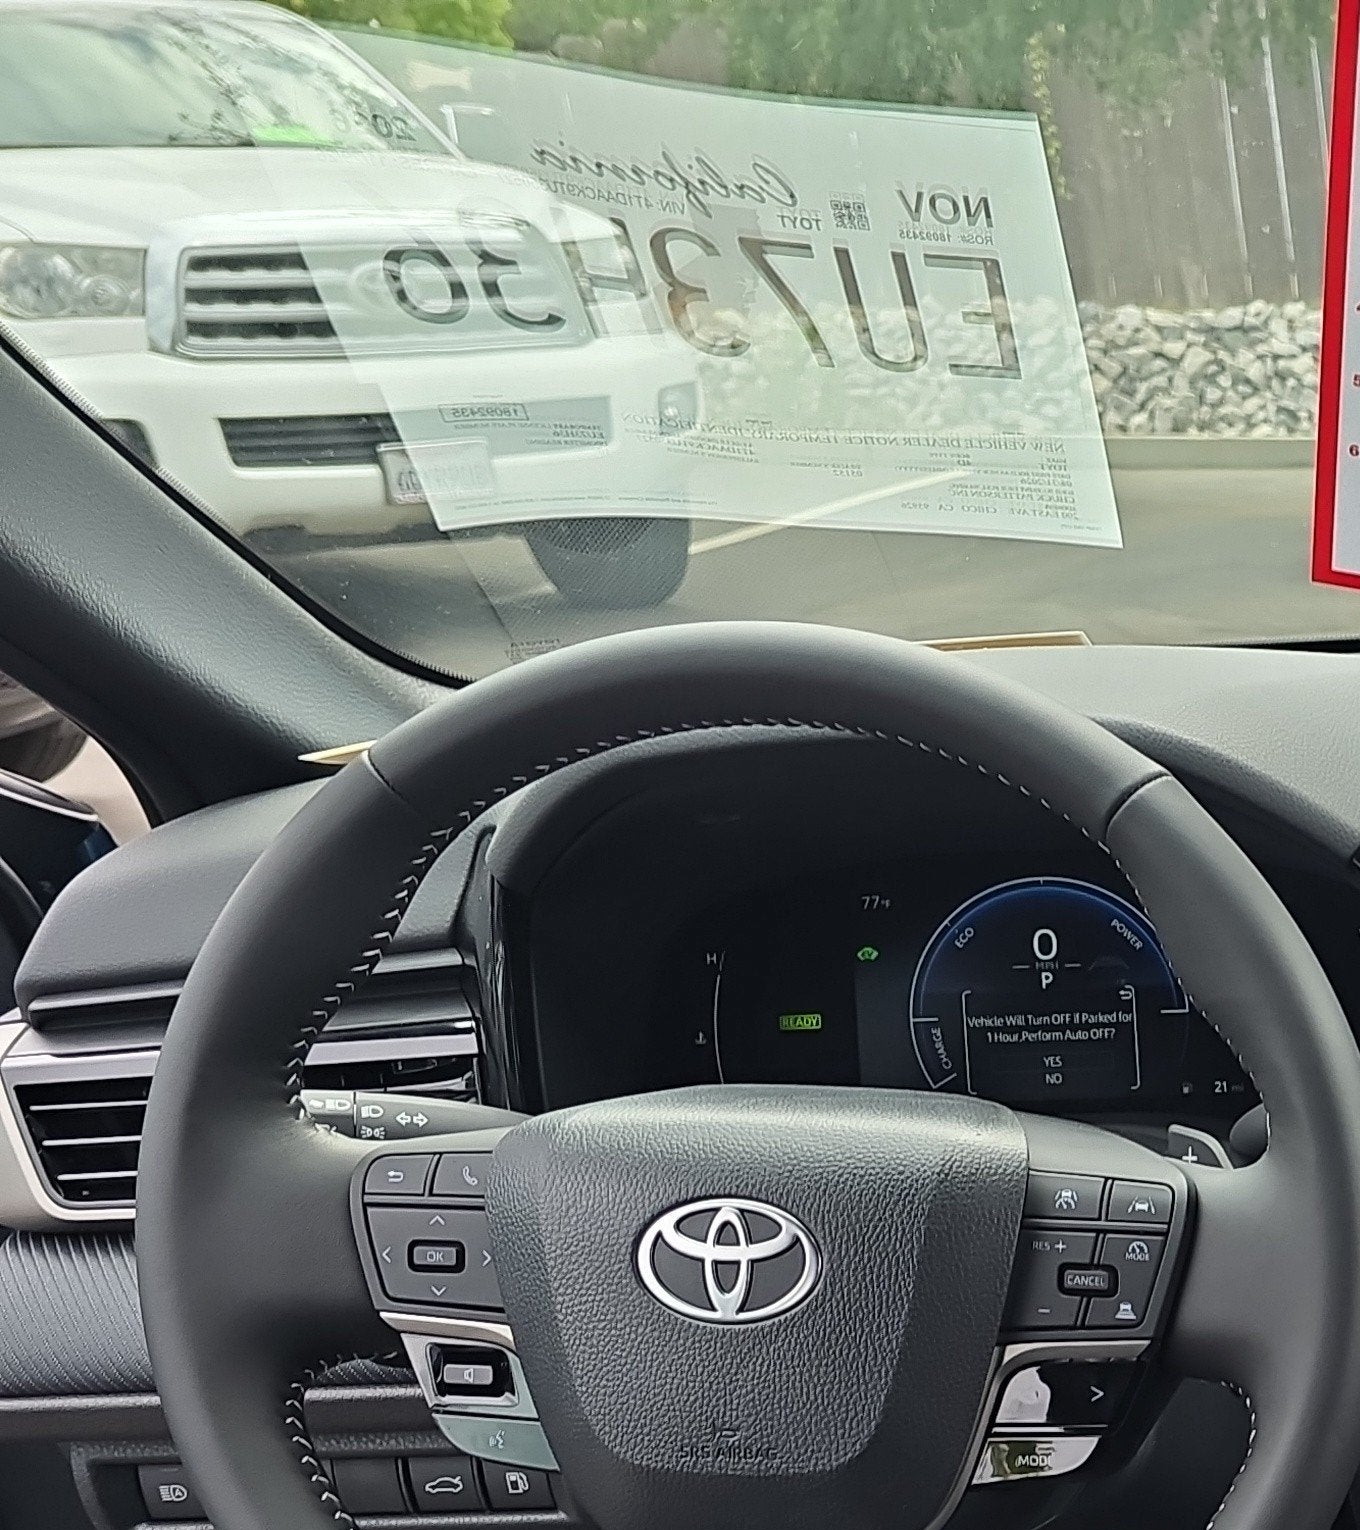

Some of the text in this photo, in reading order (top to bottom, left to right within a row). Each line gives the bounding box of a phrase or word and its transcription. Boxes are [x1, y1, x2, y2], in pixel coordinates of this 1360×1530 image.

[954, 926, 975, 949] ECO
[1110, 918, 1144, 950] POWER
[1041, 971, 1053, 989] P
[782, 1016, 819, 1029] READY
[967, 1015, 1004, 1028] Vehicle
[1005, 1014, 1025, 1027] Will
[1027, 1014, 1050, 1026] Turn
[1051, 1013, 1071, 1025] OFF
[1082, 1012, 1116, 1025] Parked
[1118, 1011, 1132, 1023] for
[1064, 1028, 1089, 1041] Auto
[1090, 1027, 1115, 1040] OFF?
[930, 1026, 953, 1070] CHARGE
[1043, 1055, 1062, 1068] YES
[1046, 1072, 1062, 1084] NO
[1214, 1080, 1228, 1094] 21
[426, 1250, 444, 1263] OK
[1126, 1253, 1150, 1261] MODE
[1067, 1275, 1106, 1287] CANCEL
